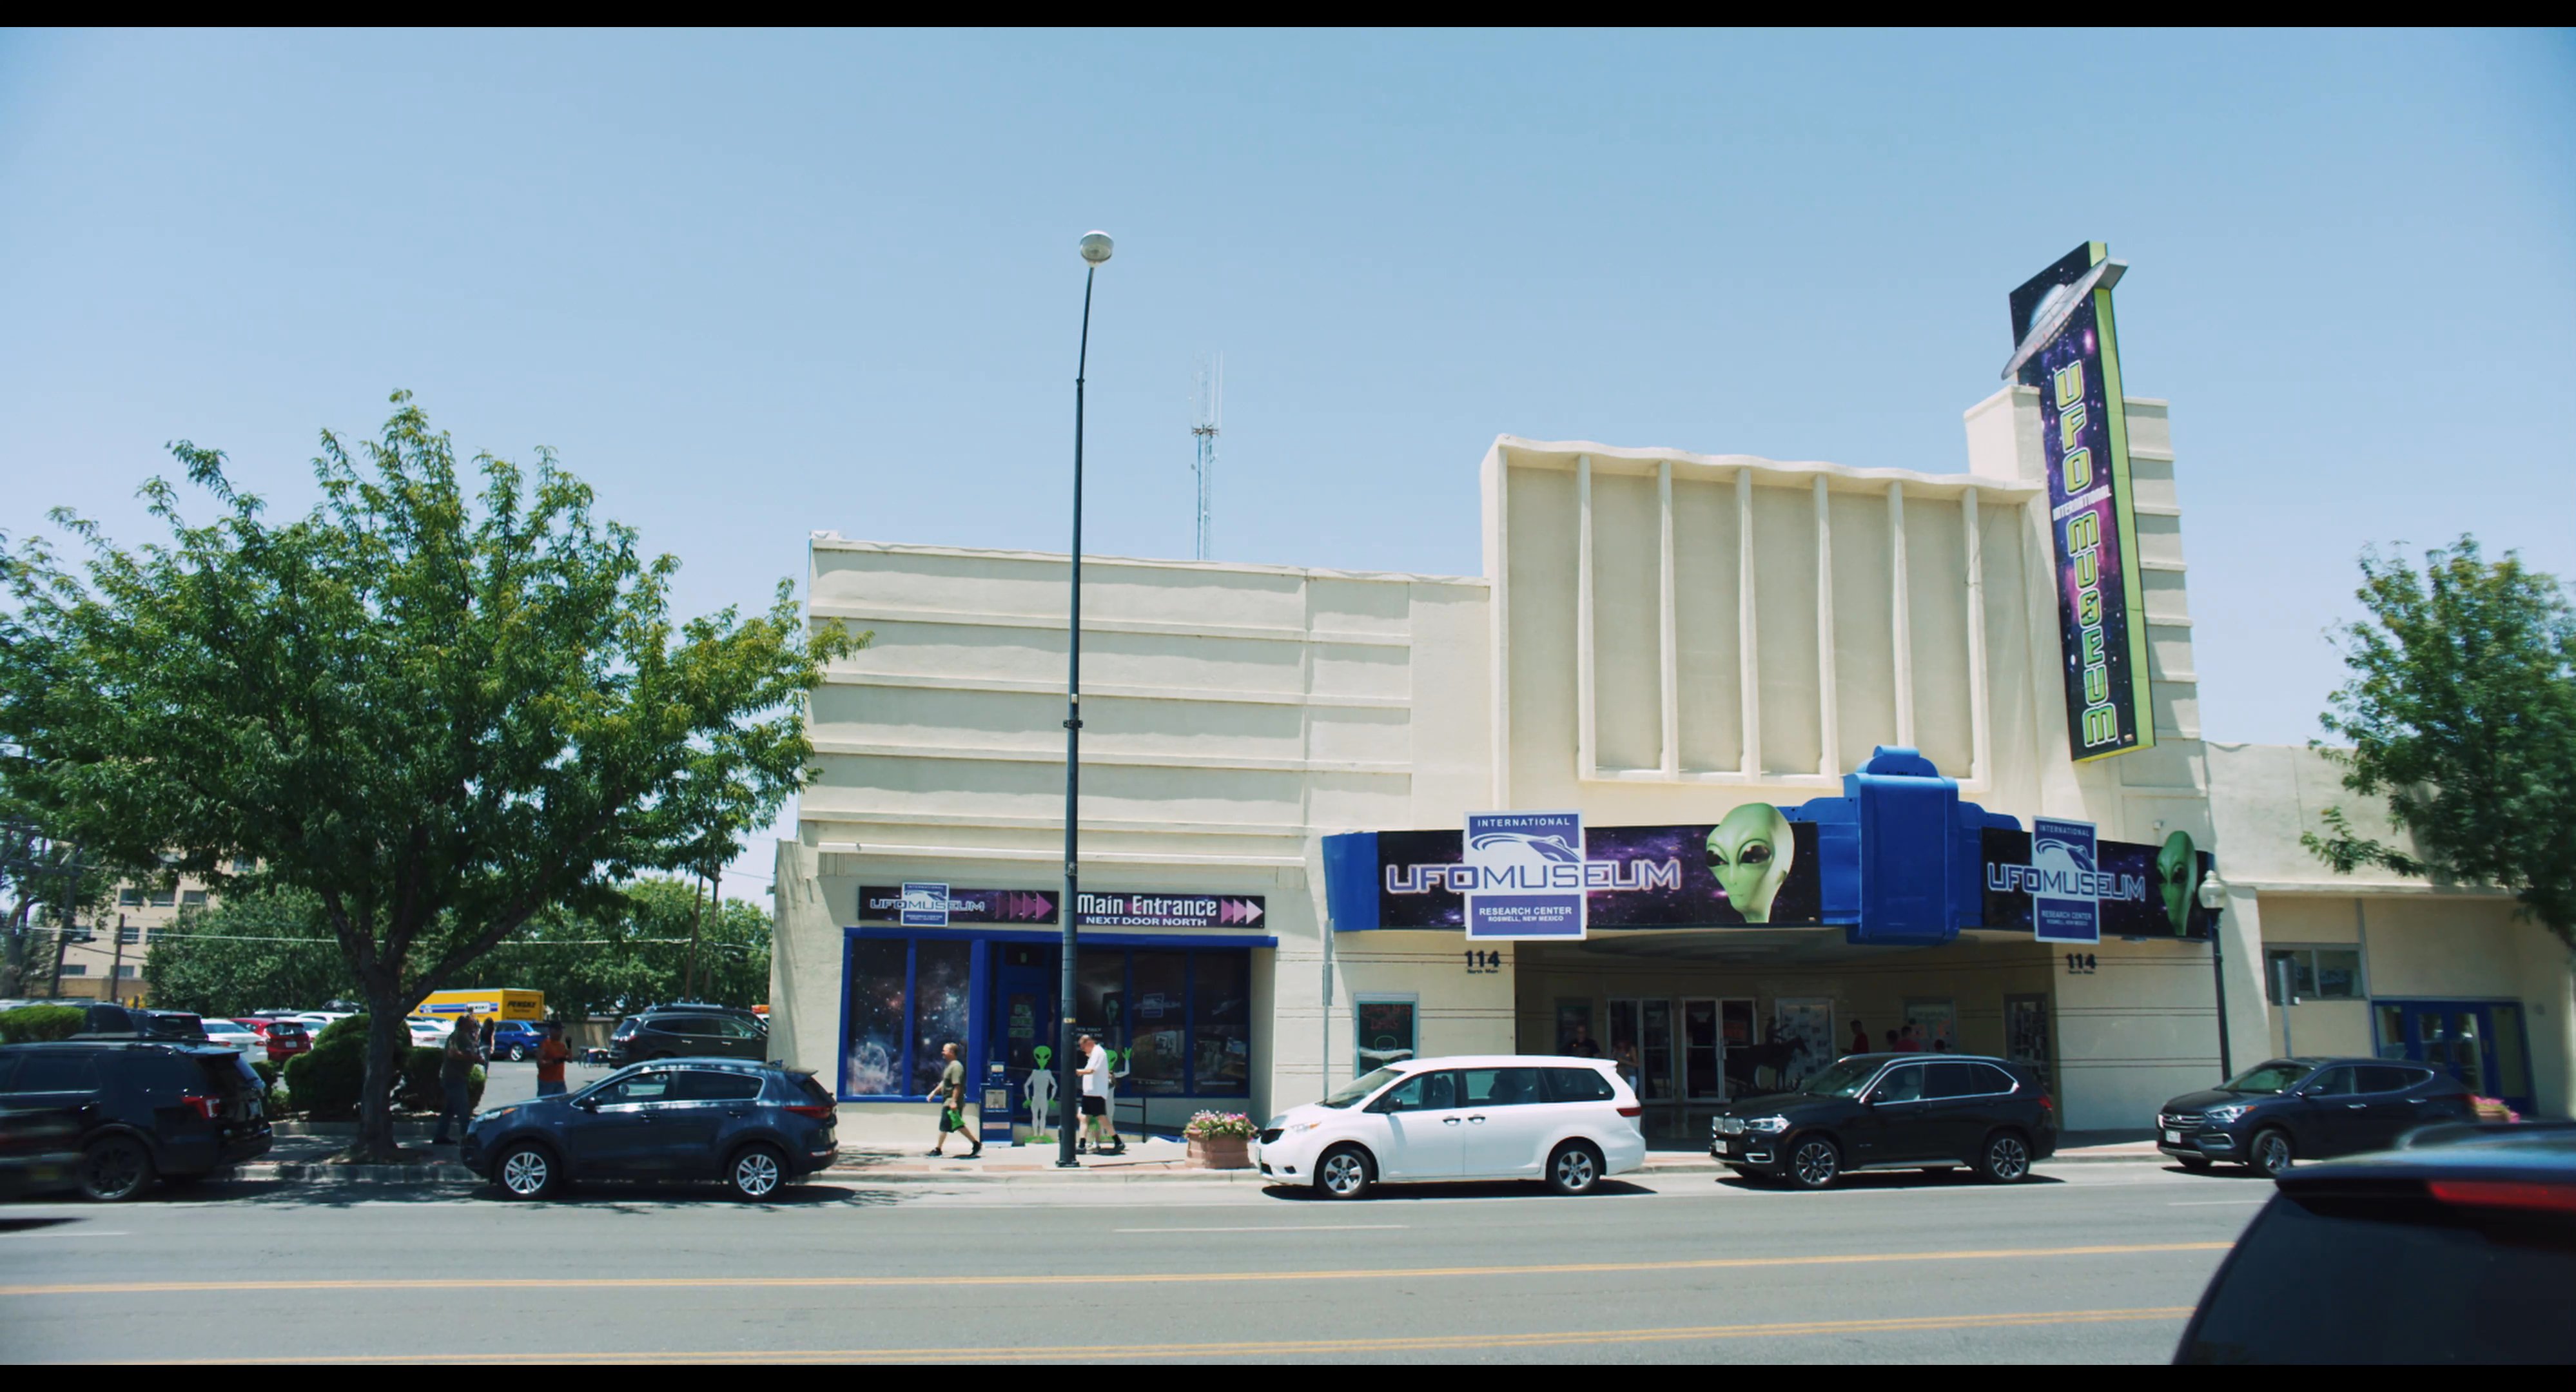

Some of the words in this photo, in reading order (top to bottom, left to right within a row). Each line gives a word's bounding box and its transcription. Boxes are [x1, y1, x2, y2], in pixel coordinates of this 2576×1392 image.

[2054, 360, 2093, 496] UFO
[2053, 484, 2113, 521] INTERNATIONAL
[2066, 510, 2118, 748] MUSEUM
[1477, 818, 1571, 827] INTERNATIONAL
[2038, 824, 2090, 837] INTERNATIONAL
[1077, 893, 1124, 914] Main
[1132, 895, 1217, 916] Entrance
[1479, 907, 1531, 916] RESEARCH
[1533, 906, 1572, 915] CENTER
[1086, 916, 1120, 924] NEXT
[1122, 916, 1160, 925] DOOR
[1162, 918, 1207, 926] NORTH
[2042, 909, 2071, 919] RESEARCH
[2071, 911, 2092, 921] CENTER
[1464, 949, 1501, 967] 114
[2065, 952, 2097, 969] 114
